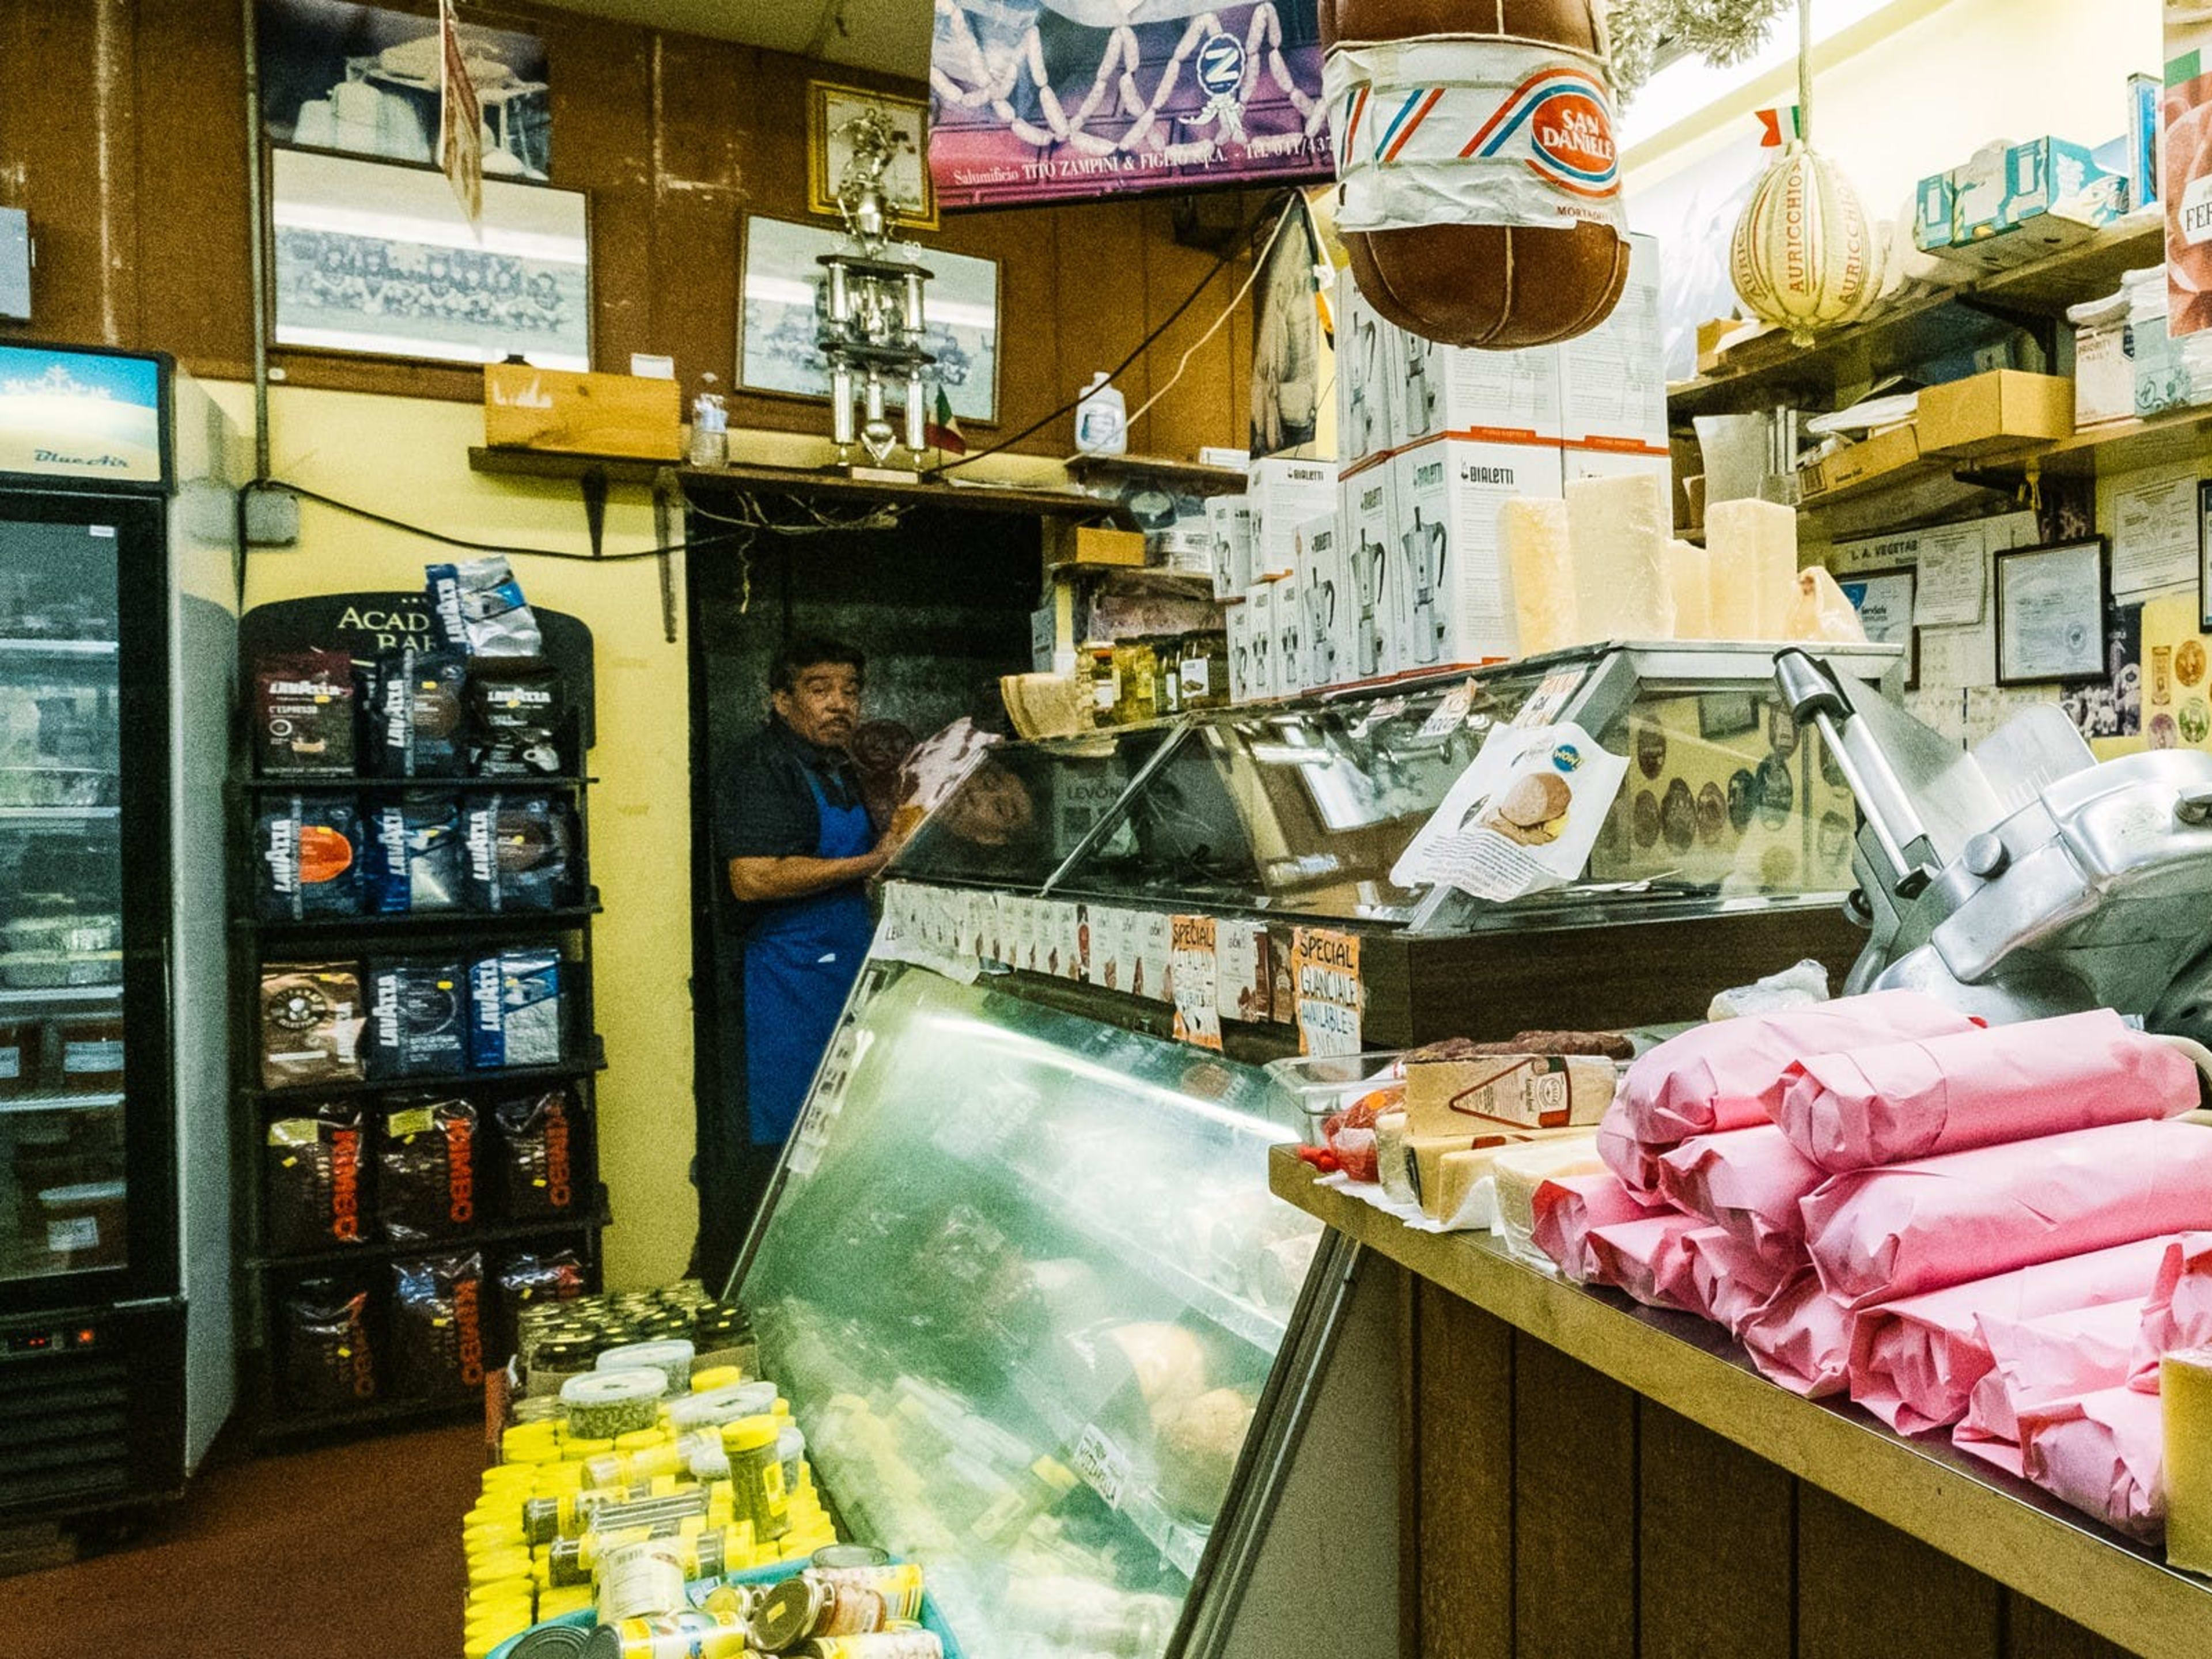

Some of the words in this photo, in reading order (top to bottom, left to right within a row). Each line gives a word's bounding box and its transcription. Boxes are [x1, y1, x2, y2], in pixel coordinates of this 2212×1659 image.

[1205, 48, 1239, 82] Z
[1542, 126, 1613, 160] DANIELE
[1562, 108, 1599, 135] SAN
[953, 166, 1019, 185] Salumificio
[1021, 160, 1056, 180] TITO
[1060, 156, 1118, 177] ZAMPINI
[1123, 156, 1134, 171] &
[1787, 175, 1804, 293] AURICCHIO
[338, 606, 430, 631] ACAD
[436, 578, 469, 645] LAVAZZA
[384, 679, 404, 748] LAVAZZA
[1067, 786, 1122, 800] LEVON
[265, 819, 291, 893] LAVAZZA
[465, 810, 490, 881] LAVAZZA
[1300, 934, 1354, 968] SPECIAL
[372, 974, 399, 1047] LAVAZZA
[471, 957, 501, 1032] LAVAZZA
[332, 1130, 358, 1241] KIMBO
[445, 1118, 473, 1222] KIMBO
